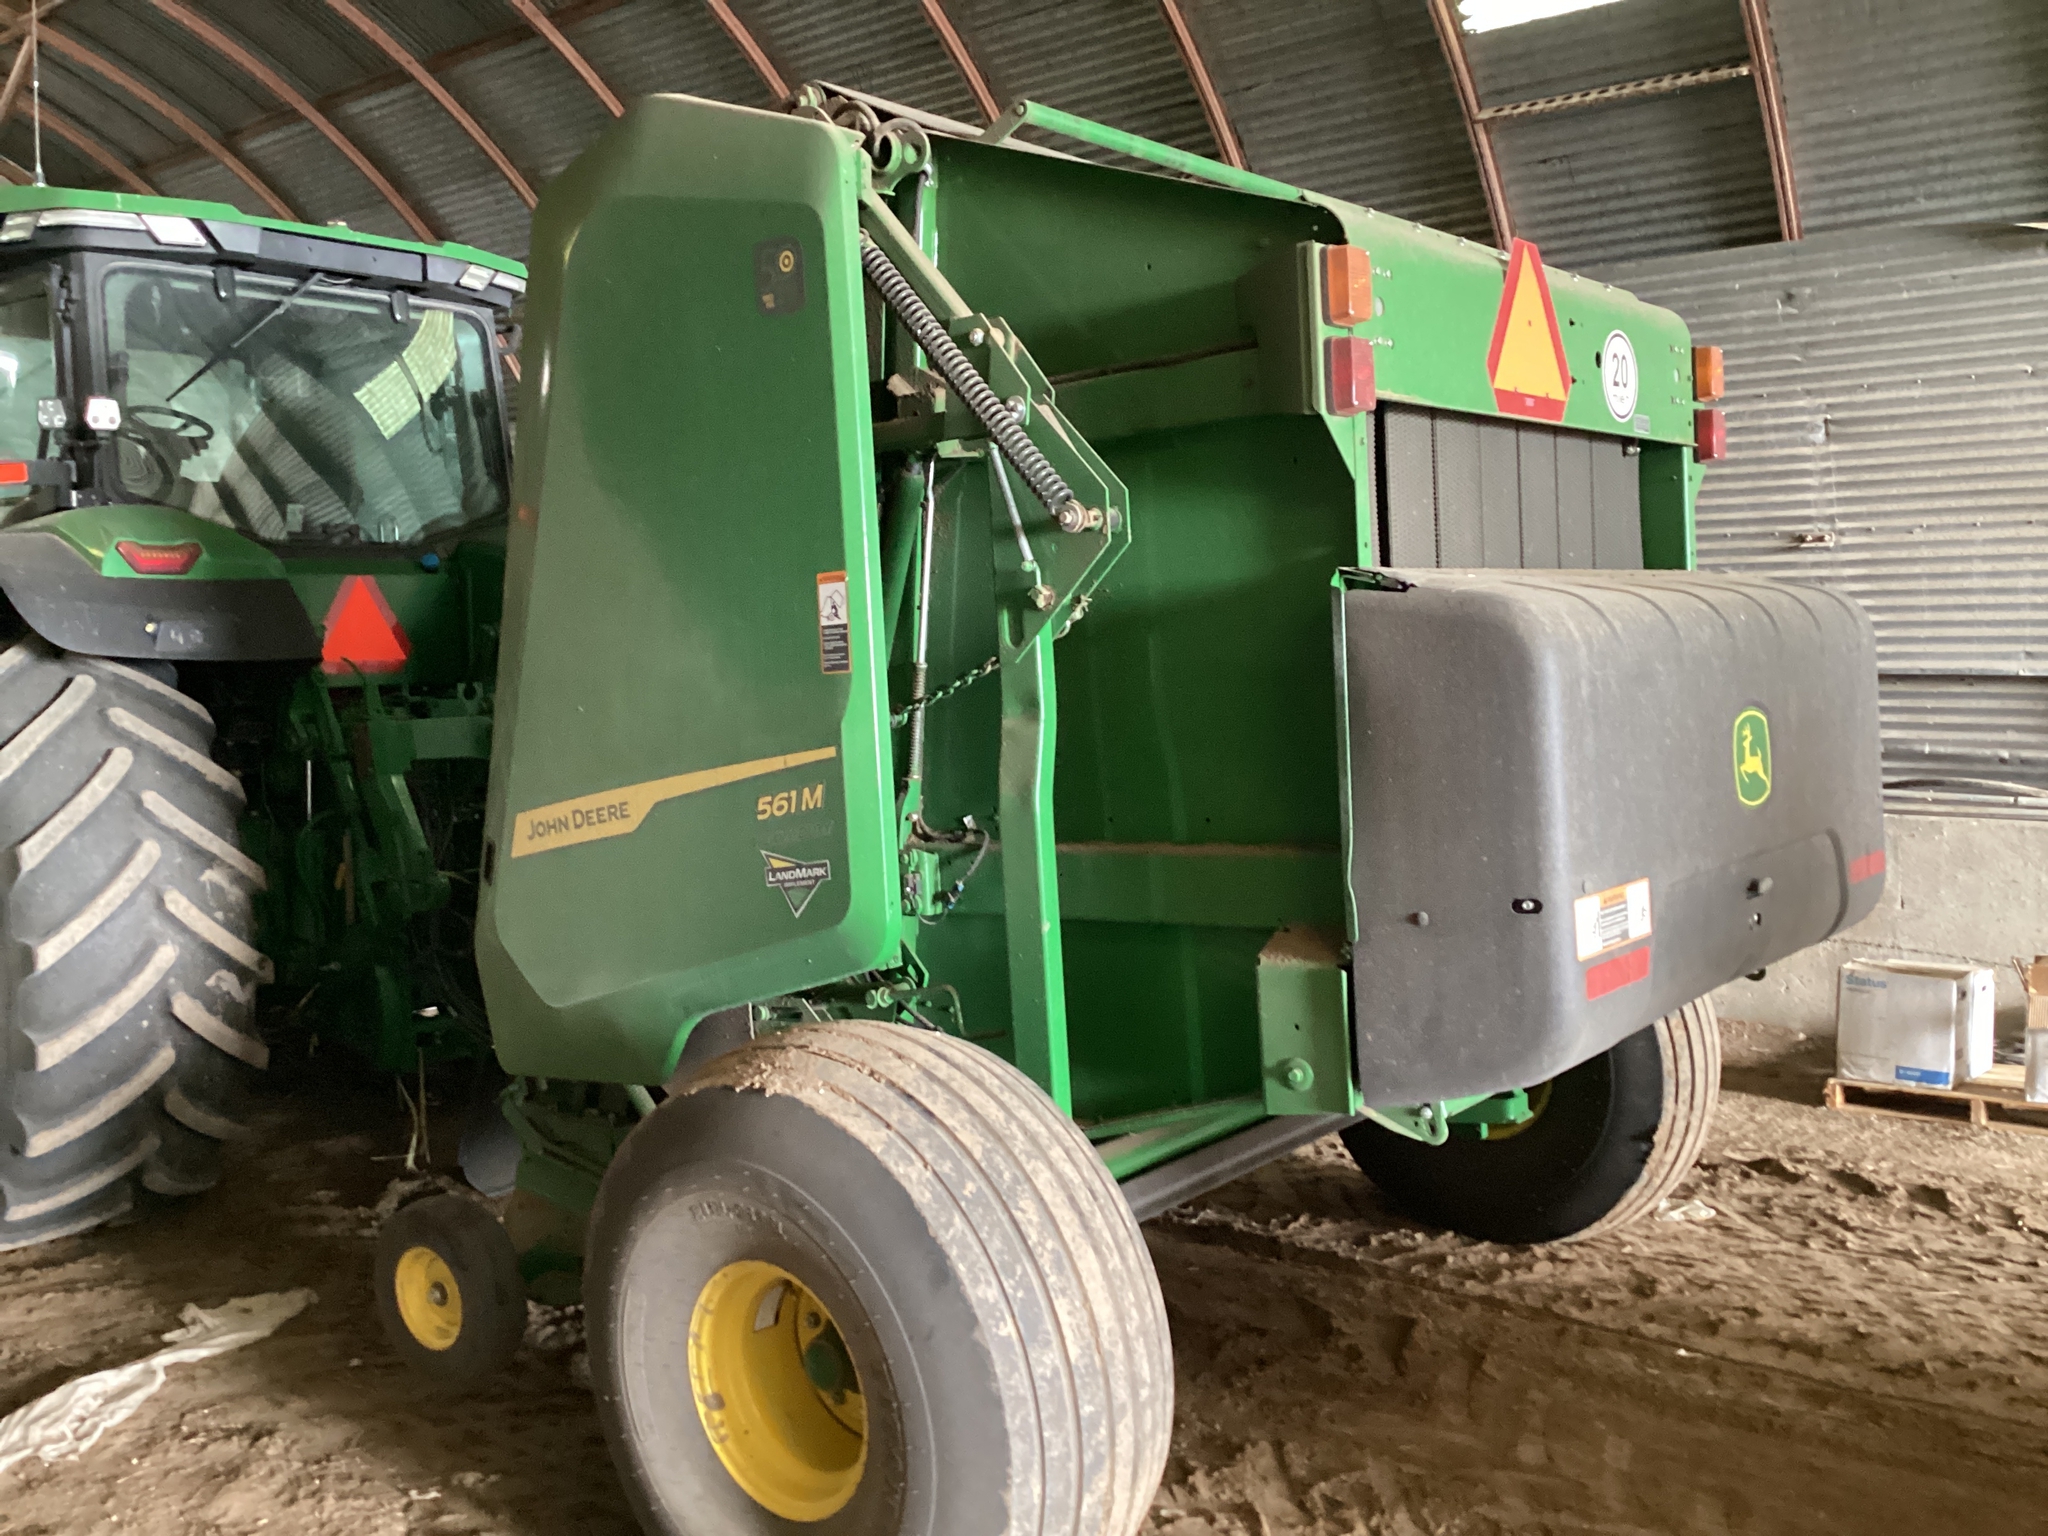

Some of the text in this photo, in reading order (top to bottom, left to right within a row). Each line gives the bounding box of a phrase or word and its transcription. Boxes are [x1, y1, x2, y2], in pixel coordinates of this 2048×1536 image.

[1612, 352, 1628, 388] 20
[527, 802, 631, 840] JOHN DEERE
[1846, 974, 1887, 989] Status
